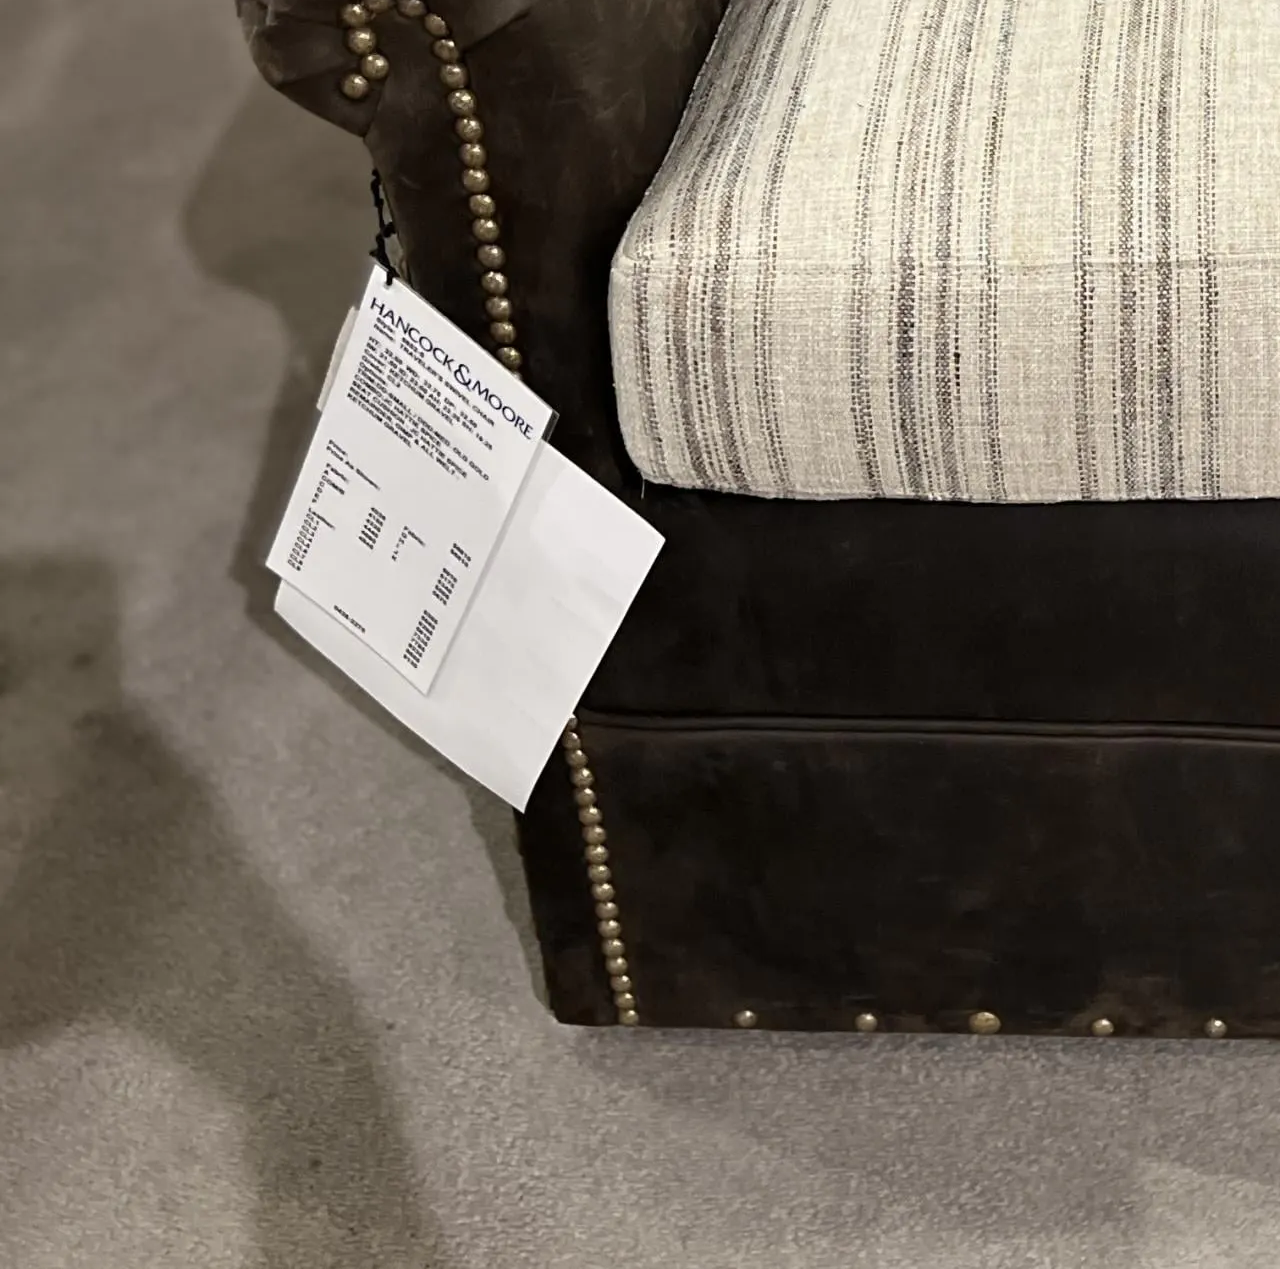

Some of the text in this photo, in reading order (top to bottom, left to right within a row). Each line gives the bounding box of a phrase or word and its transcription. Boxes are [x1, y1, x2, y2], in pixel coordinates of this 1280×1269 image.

[398, 341, 444, 383] TRAVELER'S
[443, 379, 472, 407] SWIVEL
[470, 403, 496, 427] CHAIR
